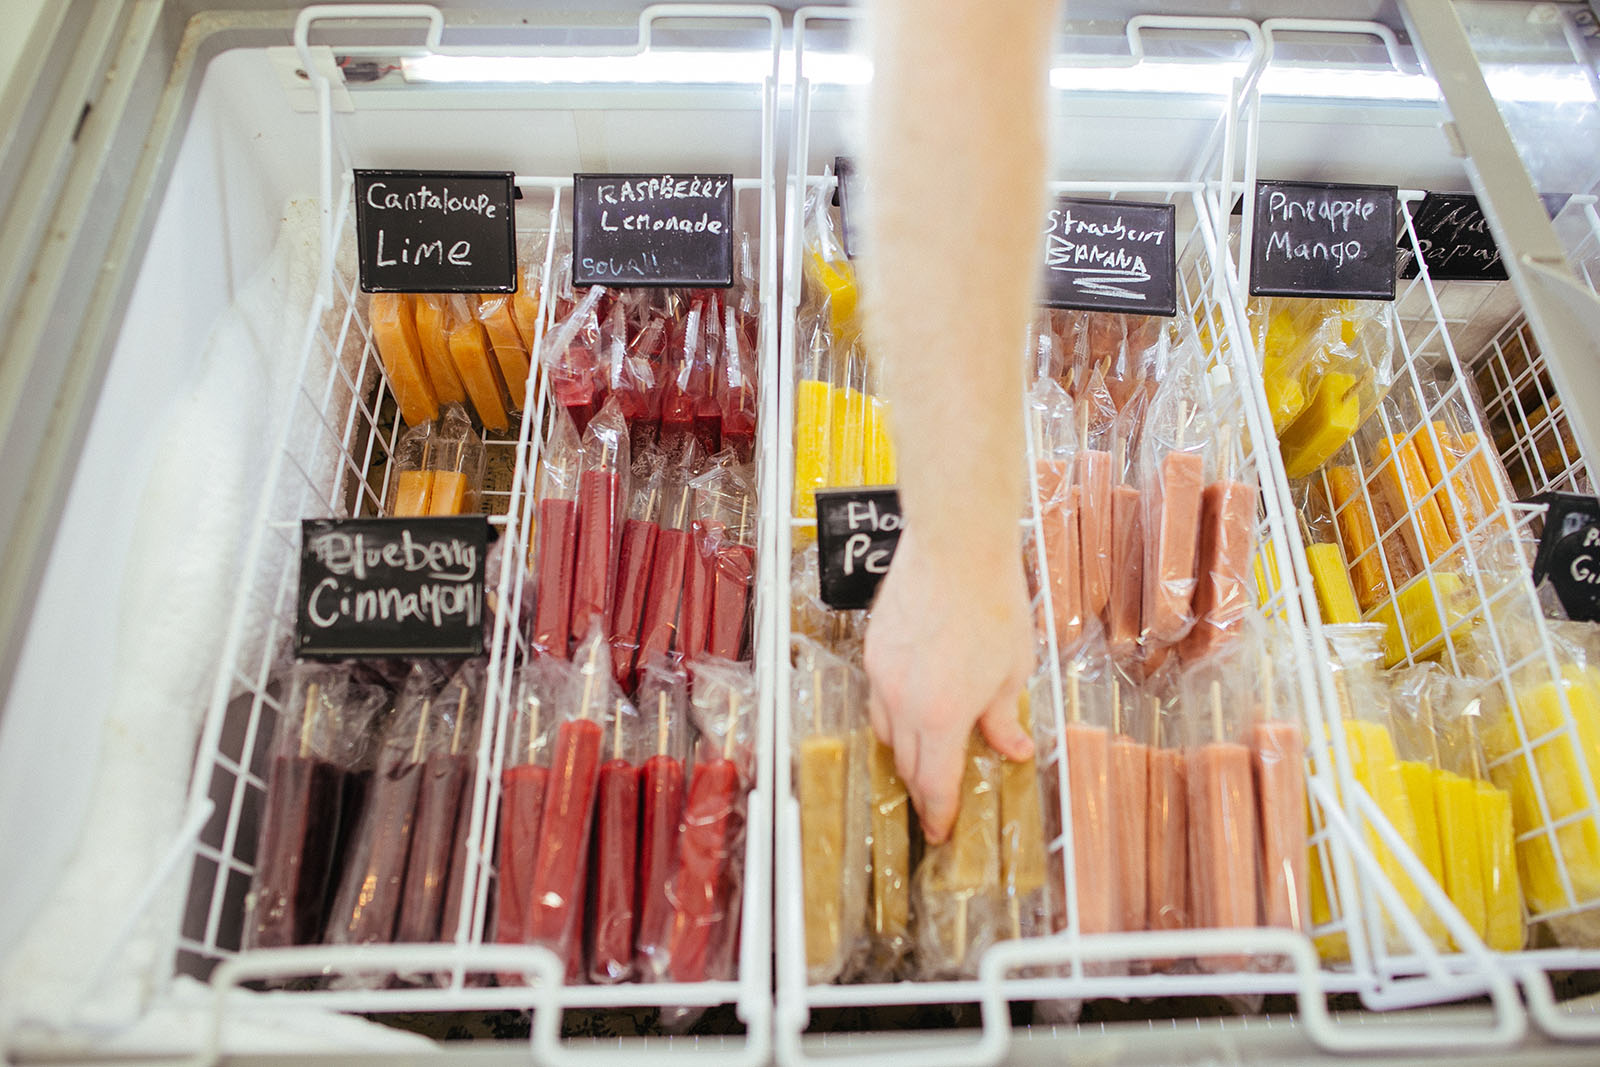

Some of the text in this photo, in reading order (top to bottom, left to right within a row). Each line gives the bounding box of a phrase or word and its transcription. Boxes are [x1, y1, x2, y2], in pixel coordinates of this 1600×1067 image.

[367, 182, 496, 219] Cantaloupe
[597, 175, 728, 205] RASPBERRY
[1269, 191, 1376, 233] Pineapple
[377, 229, 472, 267] Lime
[1045, 233, 1147, 274] BANANA
[1265, 231, 1361, 268] Mango
[1417, 239, 1503, 271] Papay
[847, 500, 905, 532] Ho
